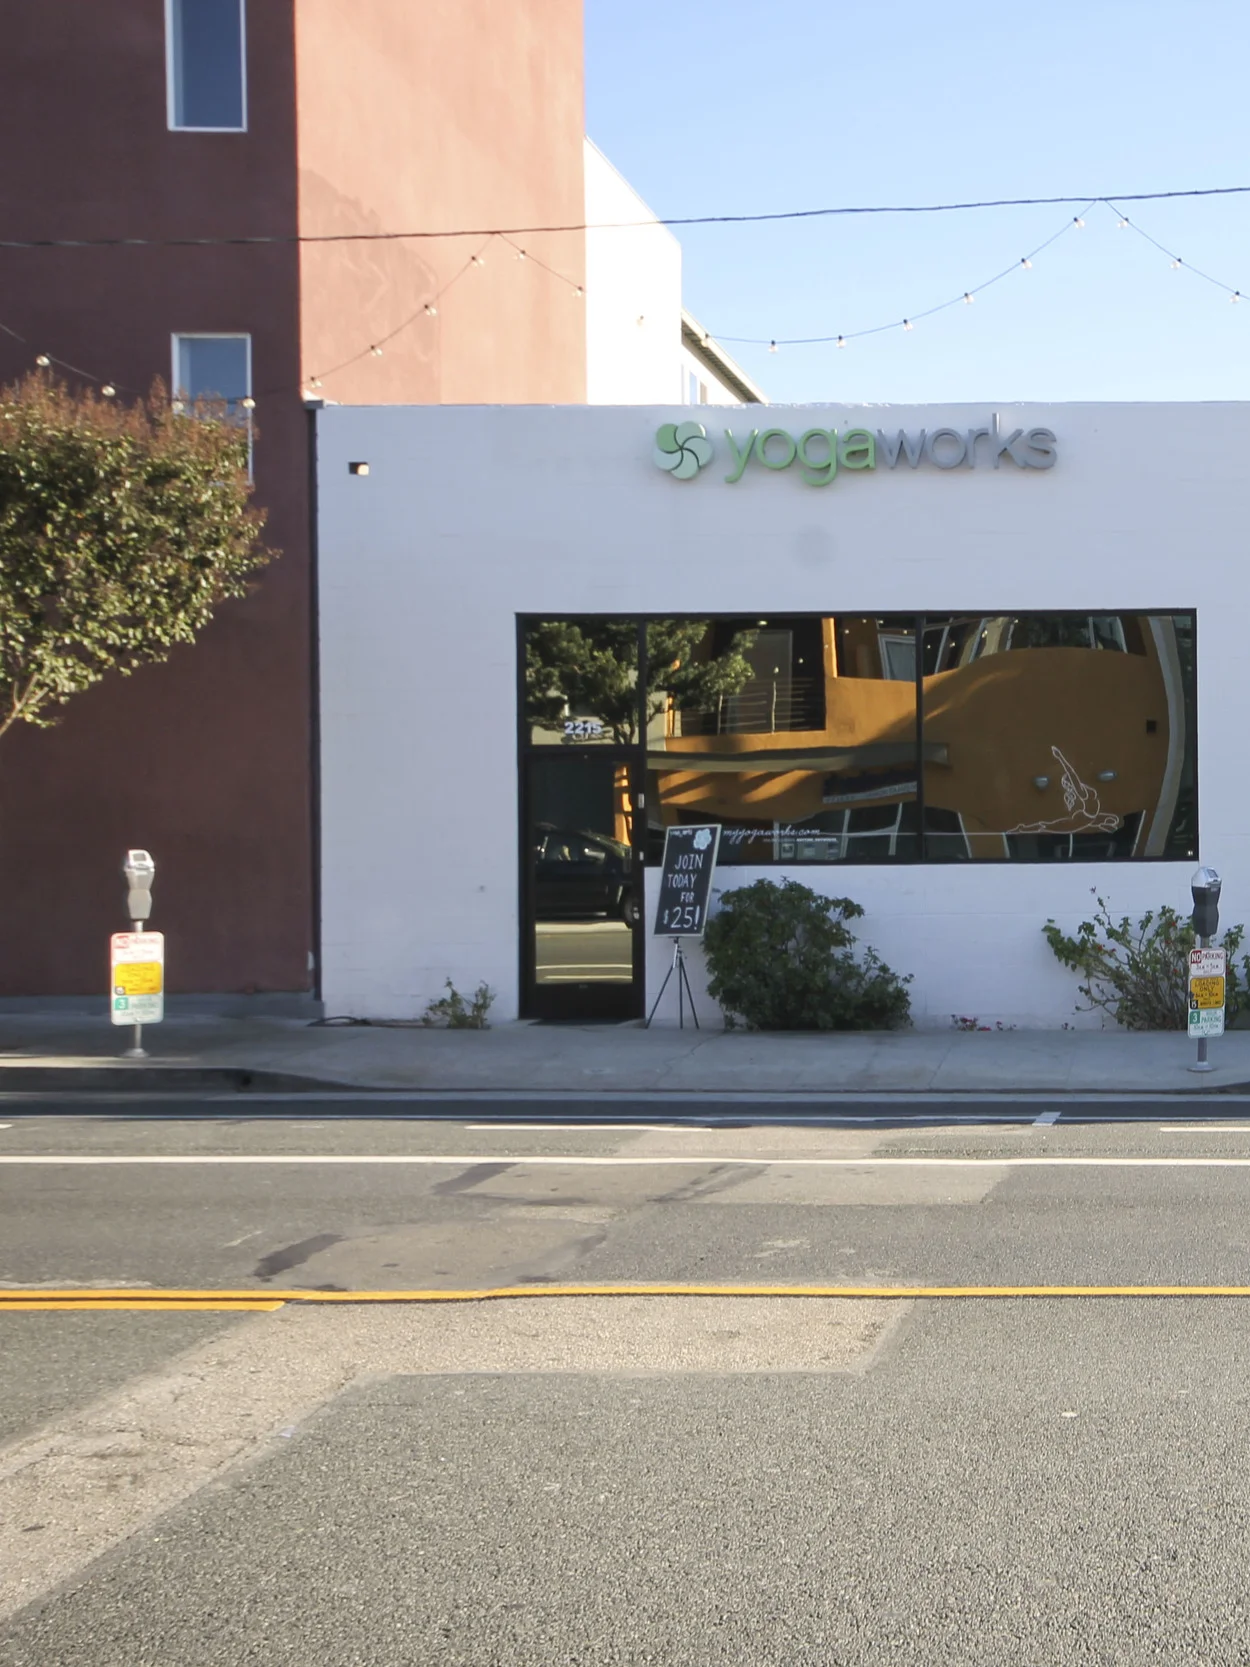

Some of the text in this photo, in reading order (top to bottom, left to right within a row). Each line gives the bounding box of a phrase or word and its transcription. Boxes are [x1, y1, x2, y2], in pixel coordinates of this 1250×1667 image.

[724, 412, 1058, 487] yogaworks
[564, 721, 602, 735] 2215
[674, 853, 704, 870] JOIN
[667, 873, 697, 889] TODAY
[680, 891, 695, 903] FOR
[1191, 952, 1201, 963] NO
